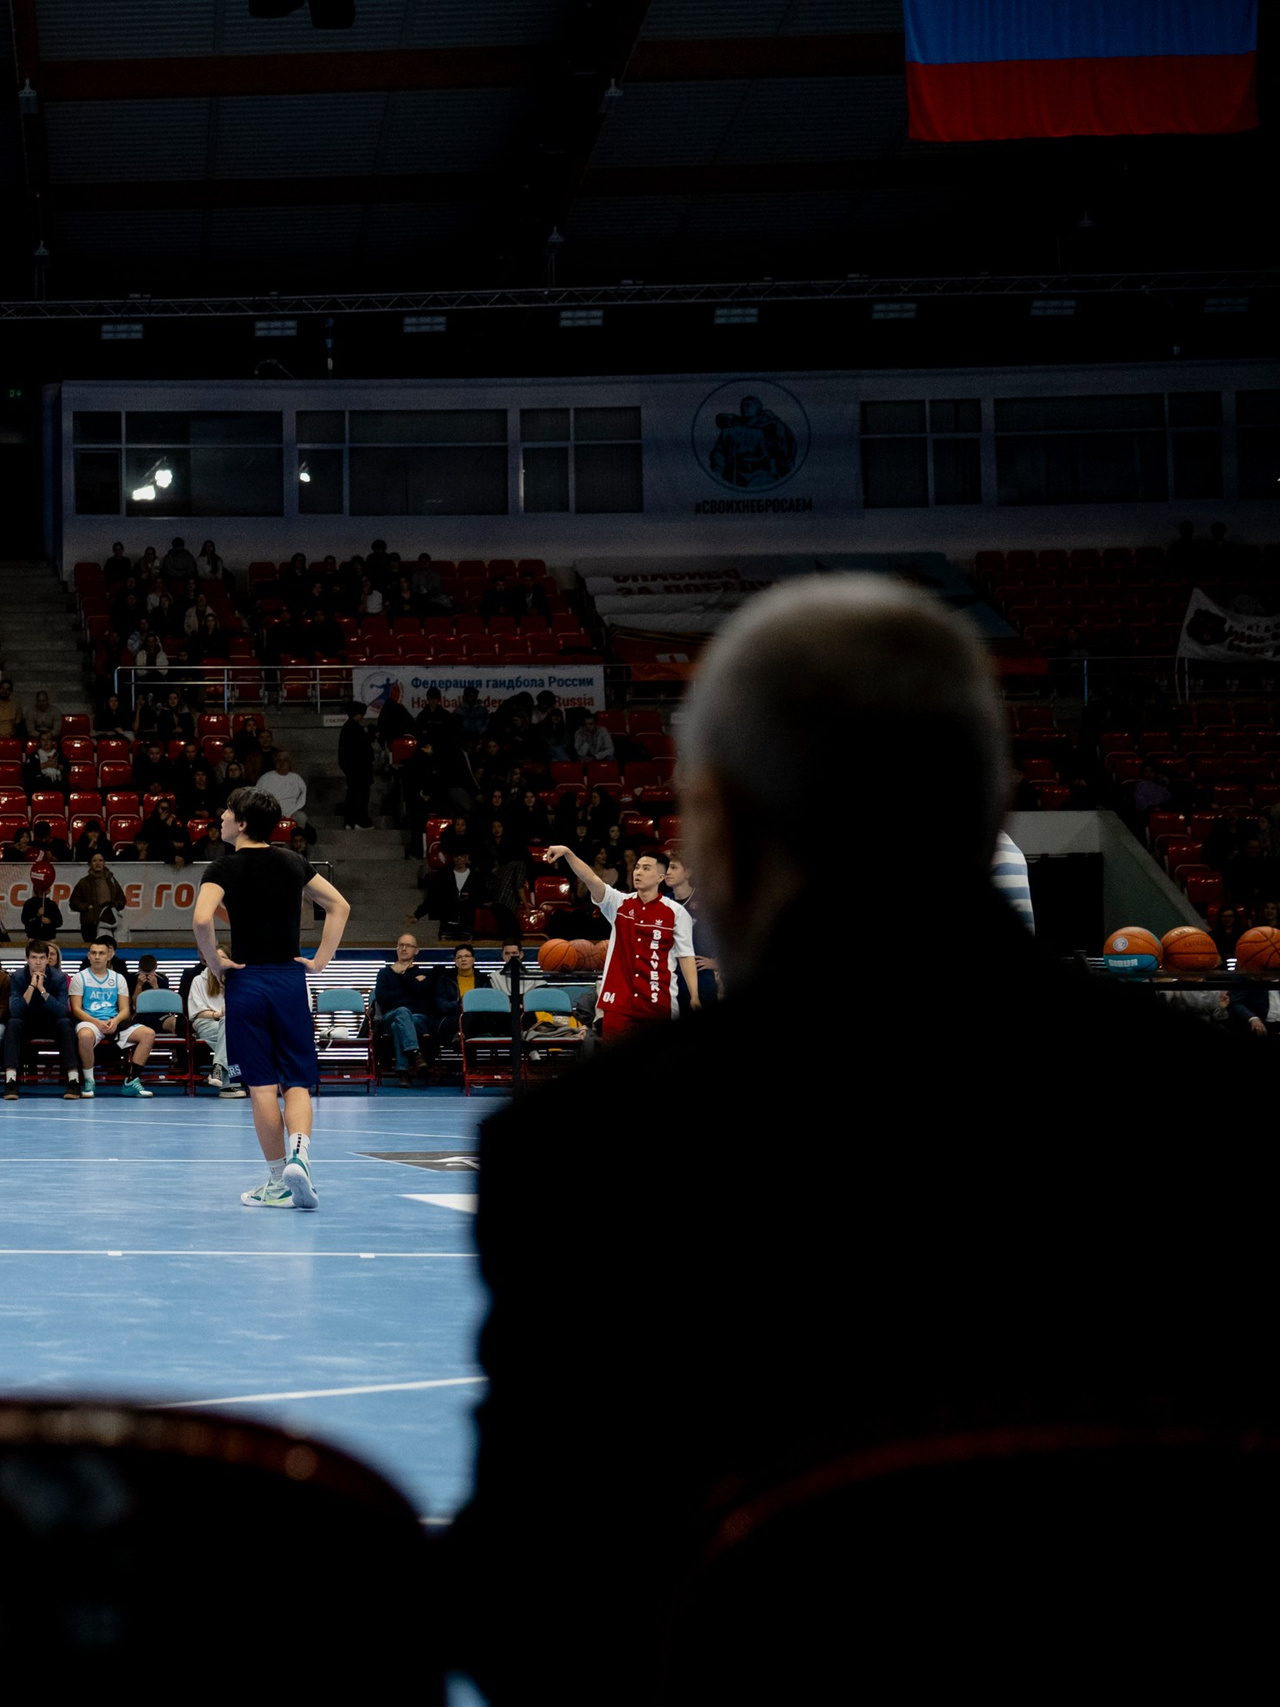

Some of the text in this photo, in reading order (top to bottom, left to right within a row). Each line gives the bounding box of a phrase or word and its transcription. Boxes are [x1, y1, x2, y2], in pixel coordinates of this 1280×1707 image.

[694, 498, 813, 514] #СВОИХНЕБРОСАЕМ
[411, 675, 594, 691] Федерация гандбола России
[649, 929, 662, 1004] BEAVERS
[602, 991, 616, 1004] 04
